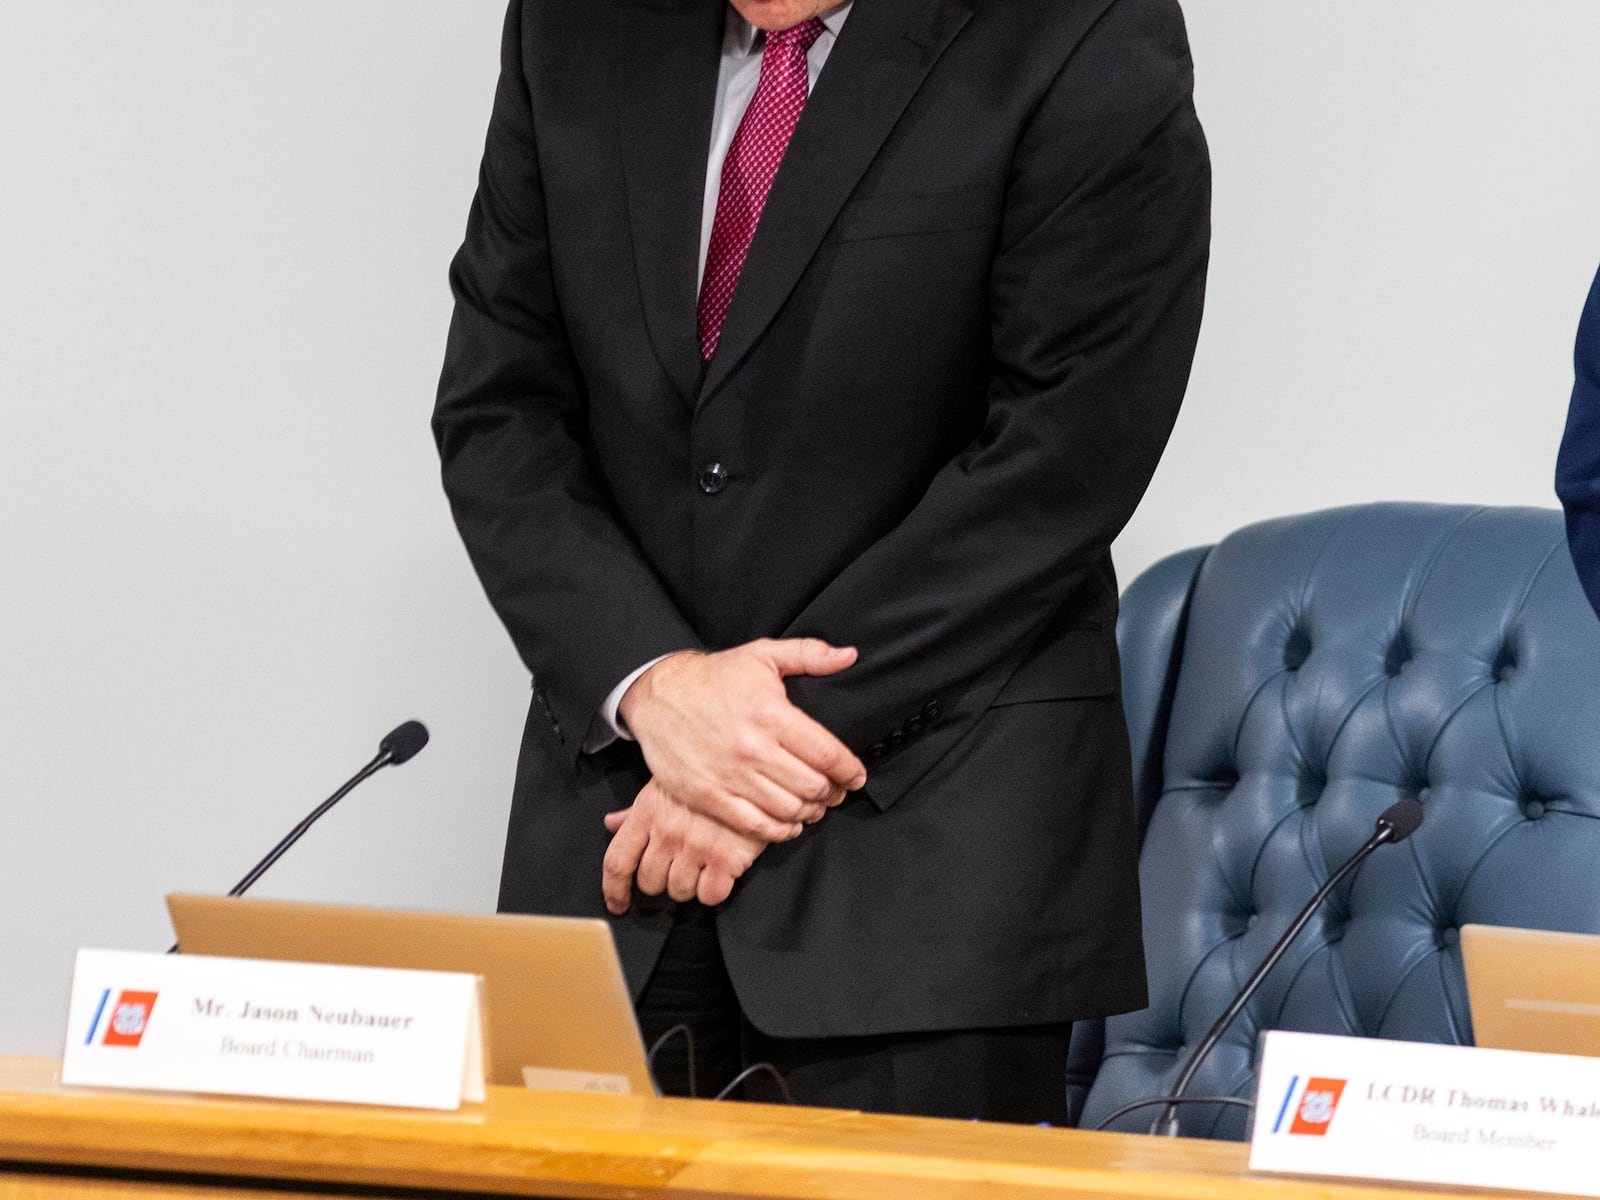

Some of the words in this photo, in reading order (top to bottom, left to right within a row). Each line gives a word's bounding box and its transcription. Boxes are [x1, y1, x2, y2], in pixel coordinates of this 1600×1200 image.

[193, 997, 231, 1019] Mr.
[238, 1000, 299, 1023] Jason
[309, 1005, 413, 1030] Neubauer
[219, 1035, 277, 1057] Board
[282, 1038, 376, 1064] Chairman
[1366, 1082, 1436, 1105] LCDR
[1447, 1088, 1529, 1112] Thomas
